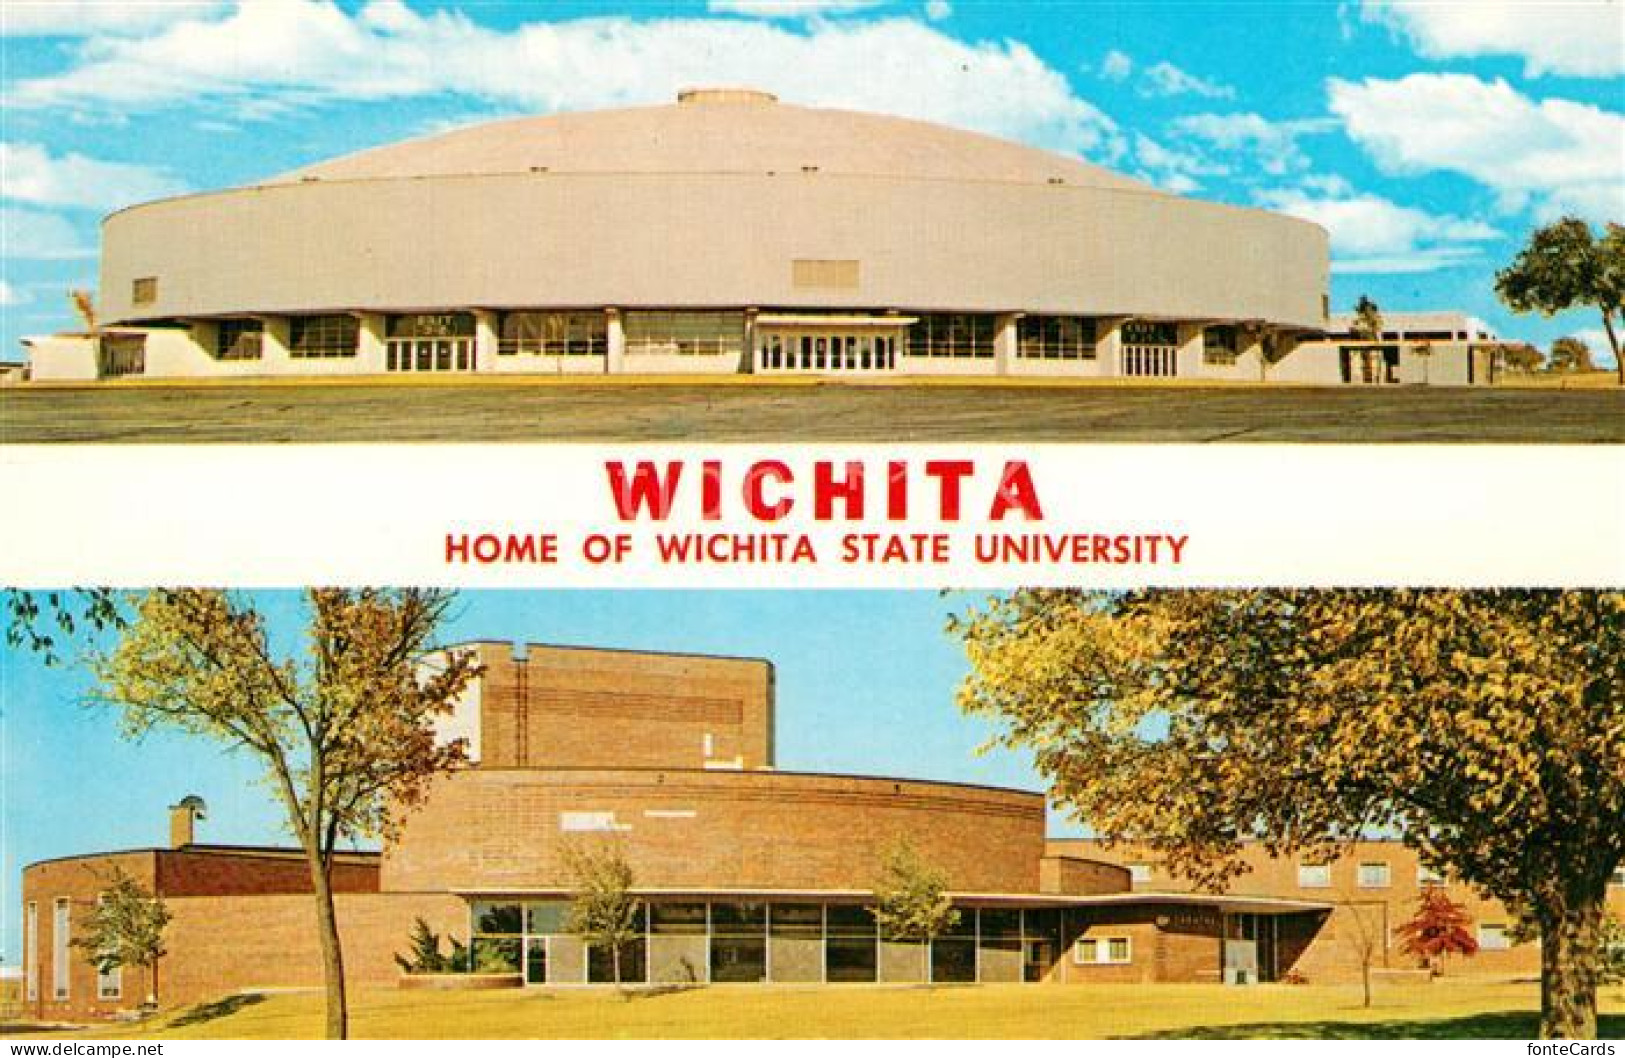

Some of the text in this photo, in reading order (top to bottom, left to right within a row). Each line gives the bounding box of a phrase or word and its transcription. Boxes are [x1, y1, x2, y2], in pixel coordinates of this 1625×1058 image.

[604, 460, 1044, 521] WICHITA
[445, 533, 1189, 564] HOME OF WICHITA STATE UNIVERSITY
